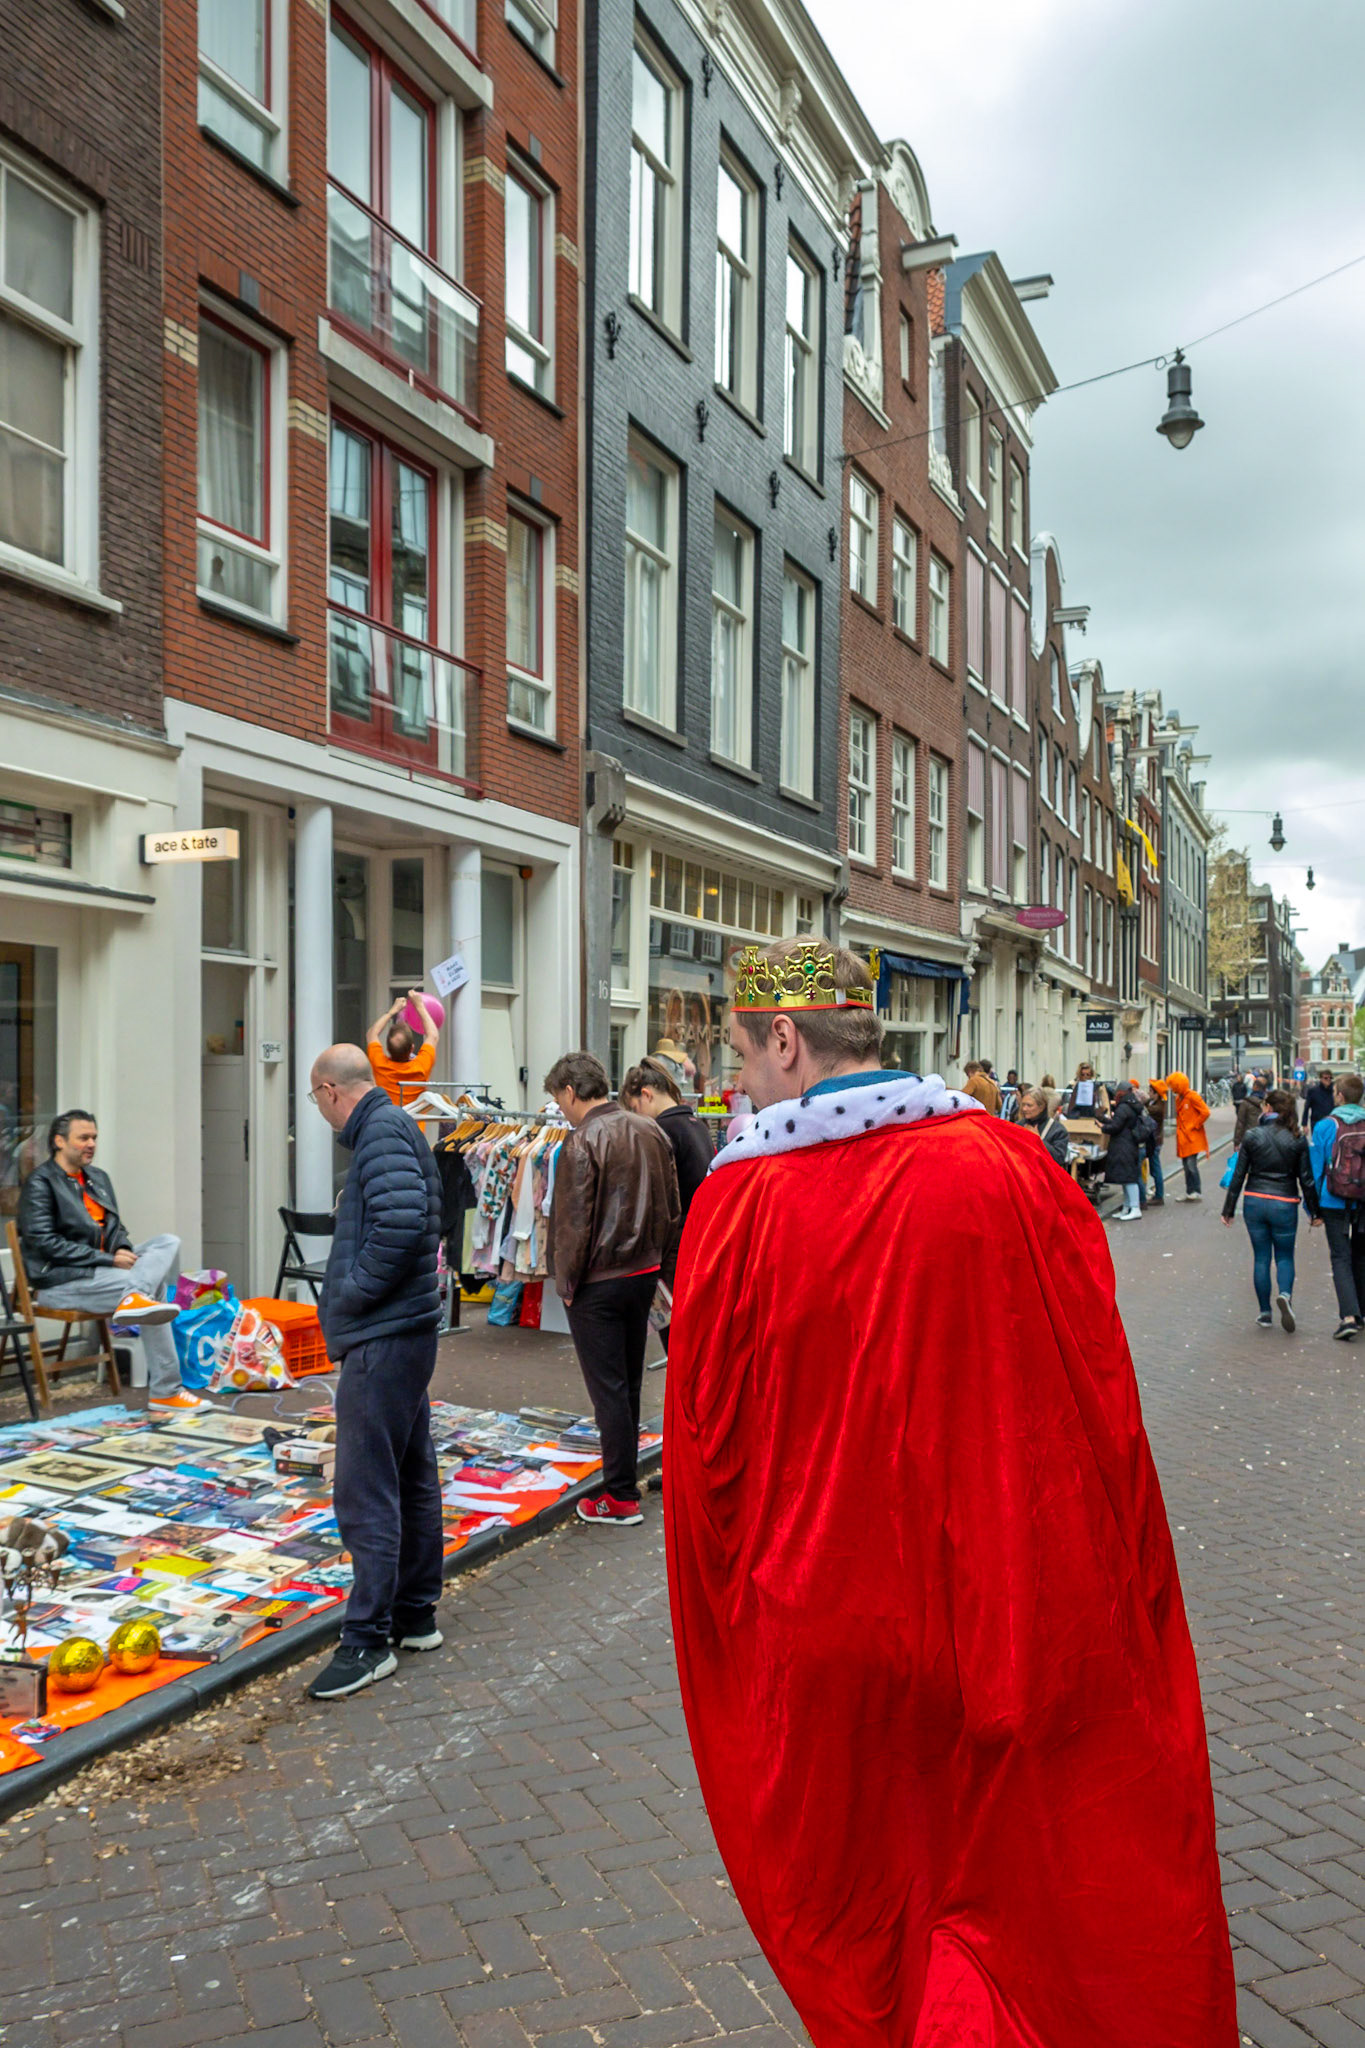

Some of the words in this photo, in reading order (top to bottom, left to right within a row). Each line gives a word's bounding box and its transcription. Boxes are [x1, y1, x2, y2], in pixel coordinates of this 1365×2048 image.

[154, 841, 178, 853] ace
[180, 838, 190, 851] &
[191, 836, 218, 849] tate
[598, 980, 608, 1000] 16
[595, 1500, 610, 1515] N
